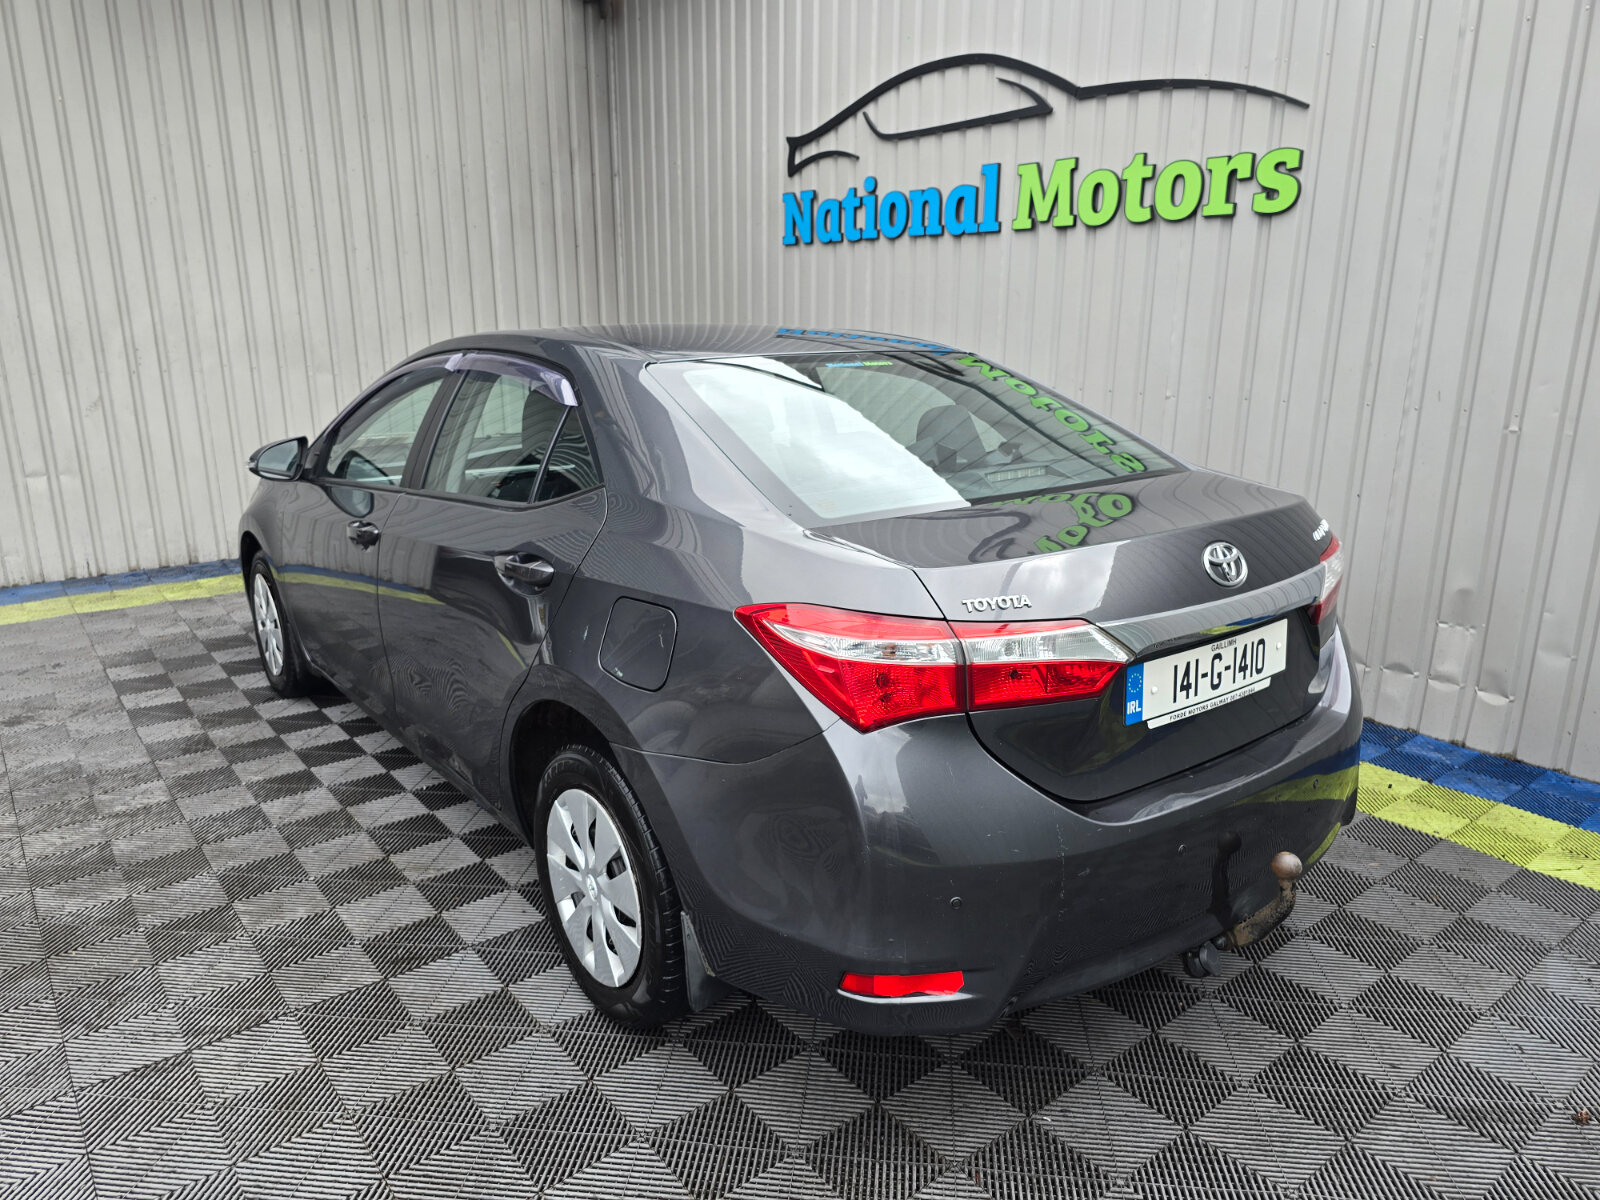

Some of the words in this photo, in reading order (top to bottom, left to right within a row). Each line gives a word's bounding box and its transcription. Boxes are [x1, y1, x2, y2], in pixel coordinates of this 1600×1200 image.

[782, 163, 1001, 246] National
[1012, 147, 1304, 232] Motors
[962, 594, 1032, 613] TOYOTA
[1211, 638, 1237, 652] GAILLIMH
[1172, 638, 1266, 704] 141-G-1410
[1126, 699, 1142, 715] IRL
[1169, 710, 1187, 722] FORDE
[1188, 704, 1209, 715] MOTORS
